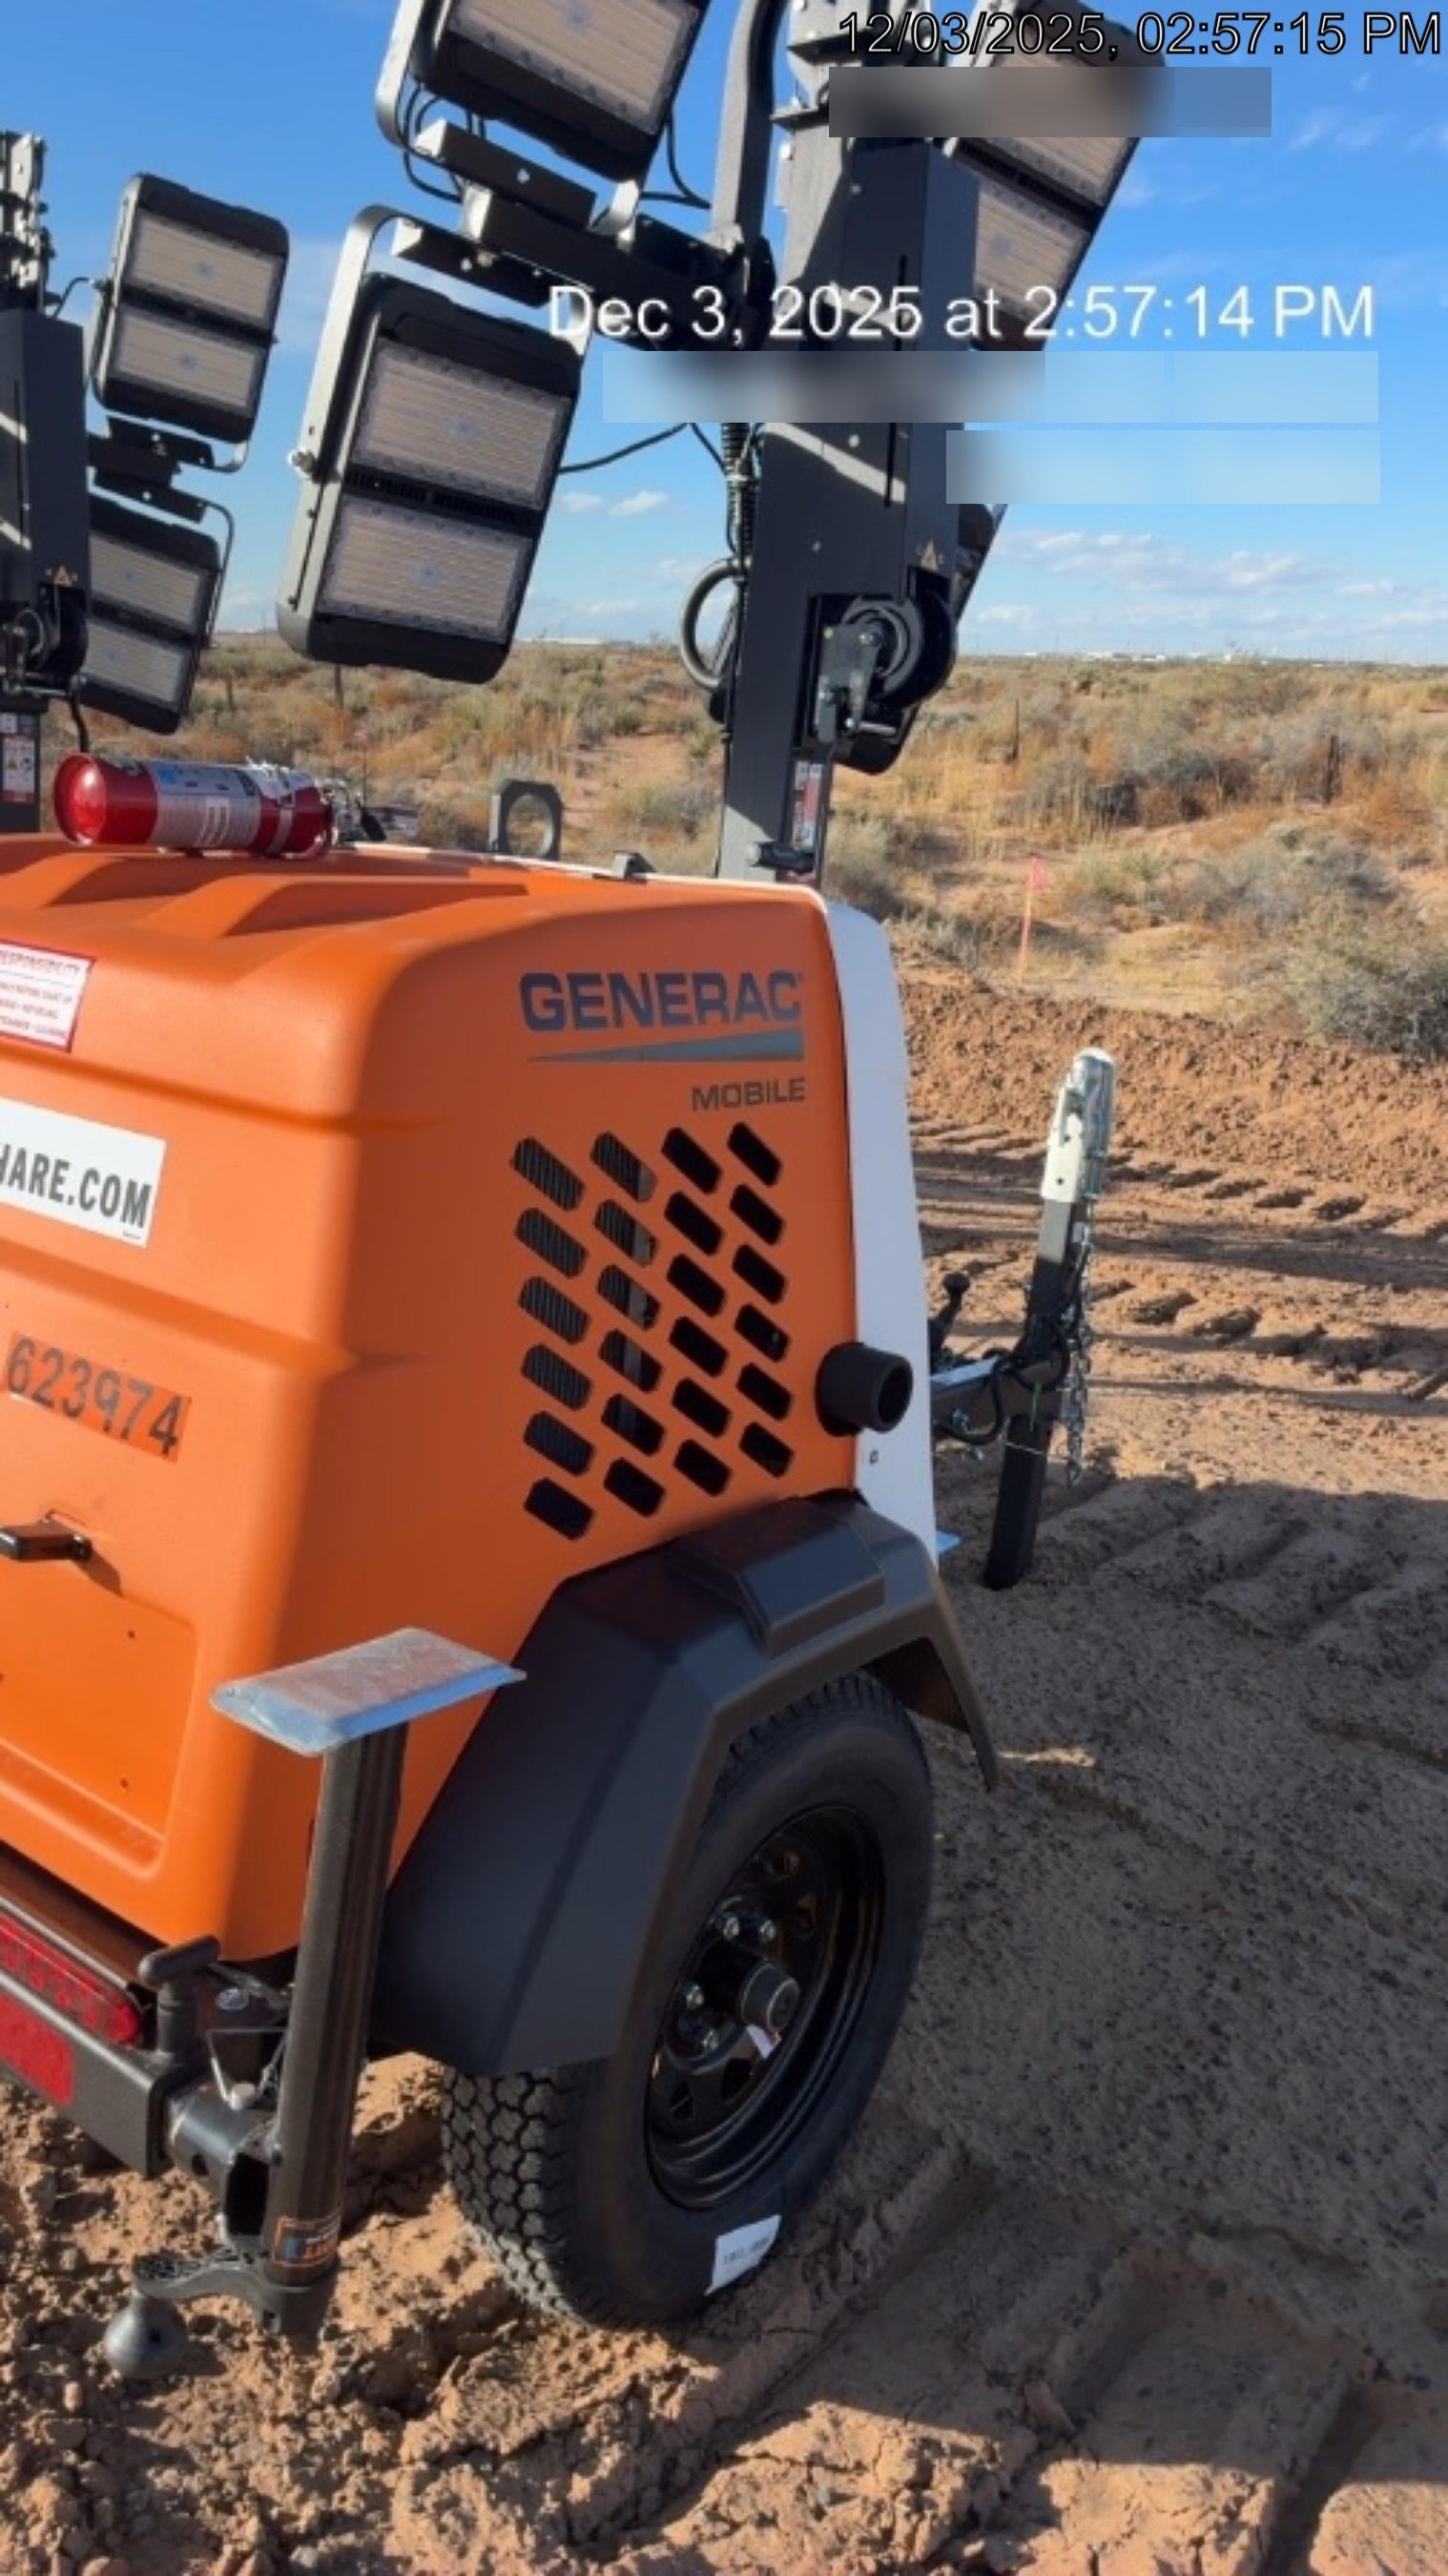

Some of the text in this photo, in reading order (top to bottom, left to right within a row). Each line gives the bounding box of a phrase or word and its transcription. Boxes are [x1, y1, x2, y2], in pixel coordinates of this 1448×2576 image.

[520, 970, 802, 1031] GENERAC
[692, 1076, 806, 1111] MOBILE
[8, 1338, 183, 1456] 623974
